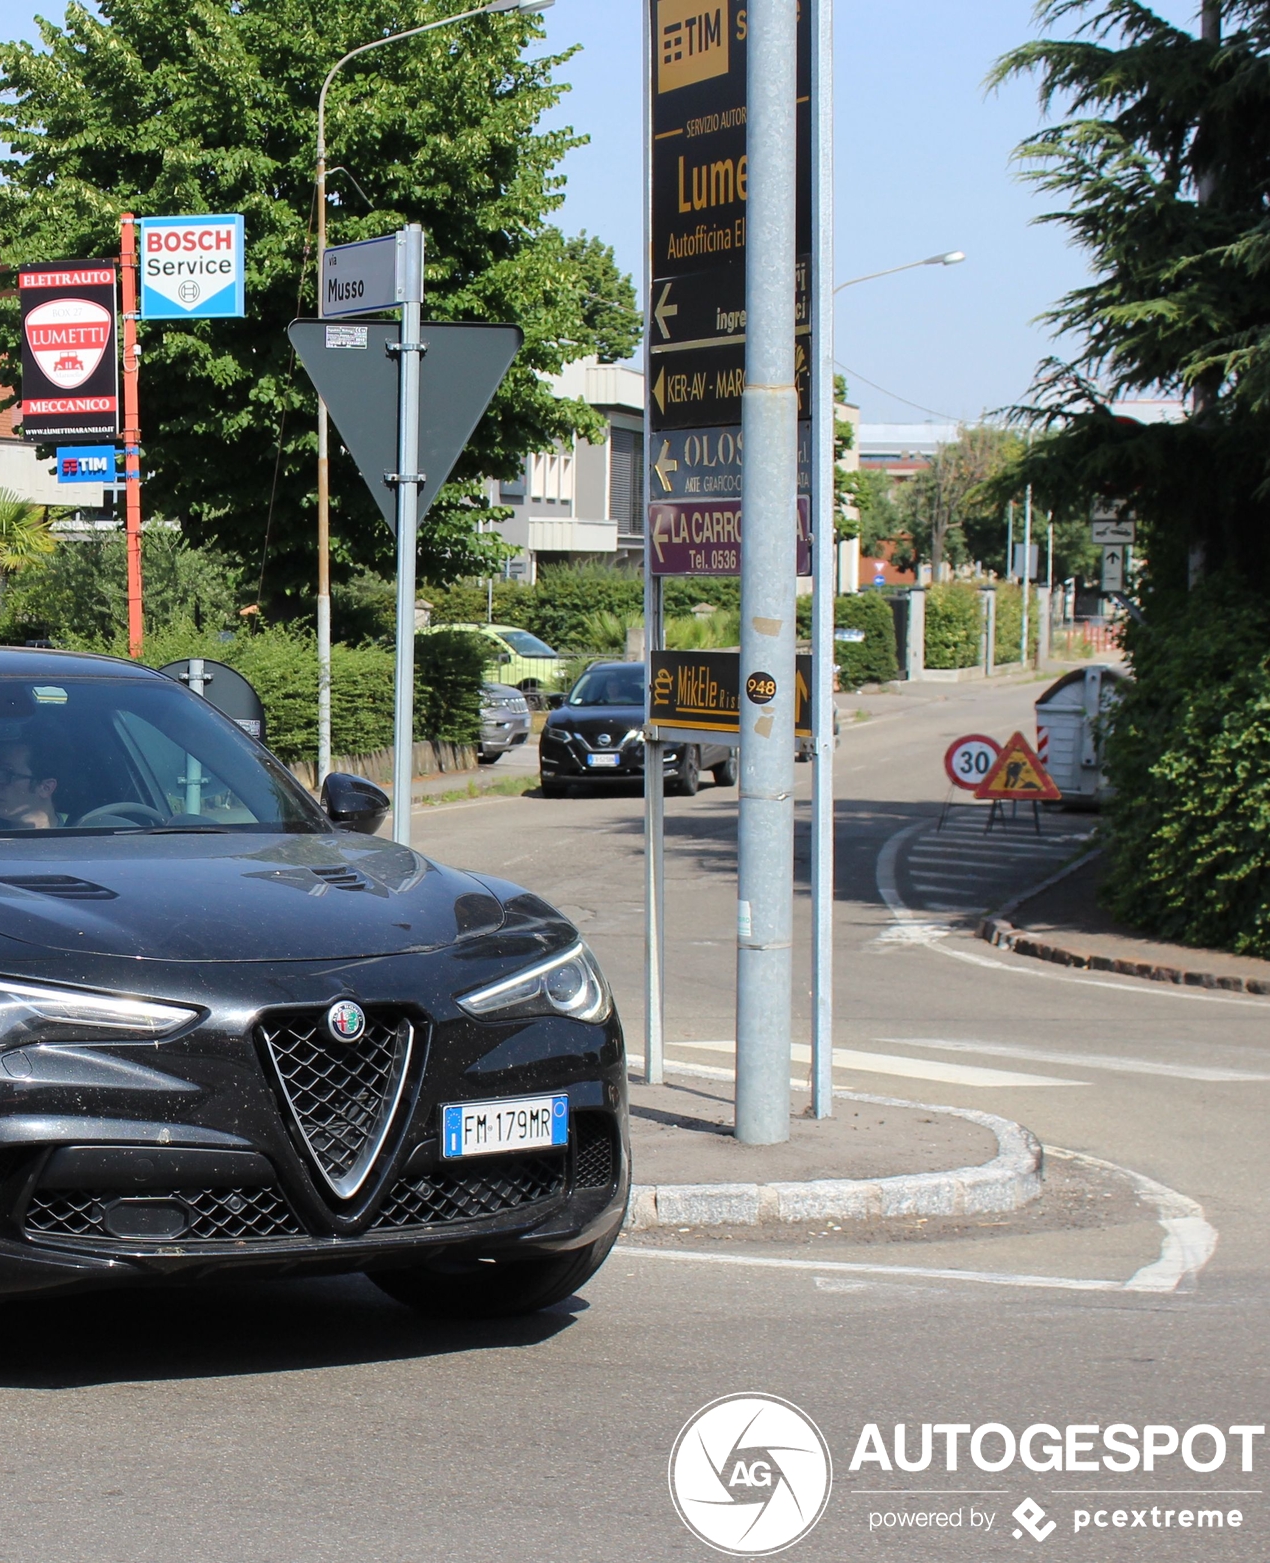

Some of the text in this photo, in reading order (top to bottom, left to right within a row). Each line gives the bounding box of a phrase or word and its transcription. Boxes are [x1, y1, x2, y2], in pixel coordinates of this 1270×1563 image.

[684, 8, 721, 56] TIM
[686, 106, 747, 139] SERVIZIO AUTOR
[678, 154, 748, 214] Lume
[147, 230, 232, 252] BOSCH
[667, 217, 746, 260] Autofficina El
[146, 255, 232, 276] Service
[329, 254, 337, 266] via
[23, 271, 111, 287] ELETTRAUTO
[328, 278, 365, 303] Musso
[52, 307, 83, 318] BOX 27
[716, 307, 747, 333] ingre
[32, 327, 105, 345] LUMETTI
[667, 372, 707, 403] KER-AV
[716, 368, 745, 399] MAR
[29, 398, 110, 413] MECCANICO
[78, 457, 108, 472] TIM
[685, 476, 701, 493] ARTE
[670, 510, 742, 544] LA CARRO
[689, 550, 737, 569] Tel. 0536
[676, 665, 718, 708] MikEle
[747, 678, 776, 695] 948
[960, 751, 990, 774] 30
